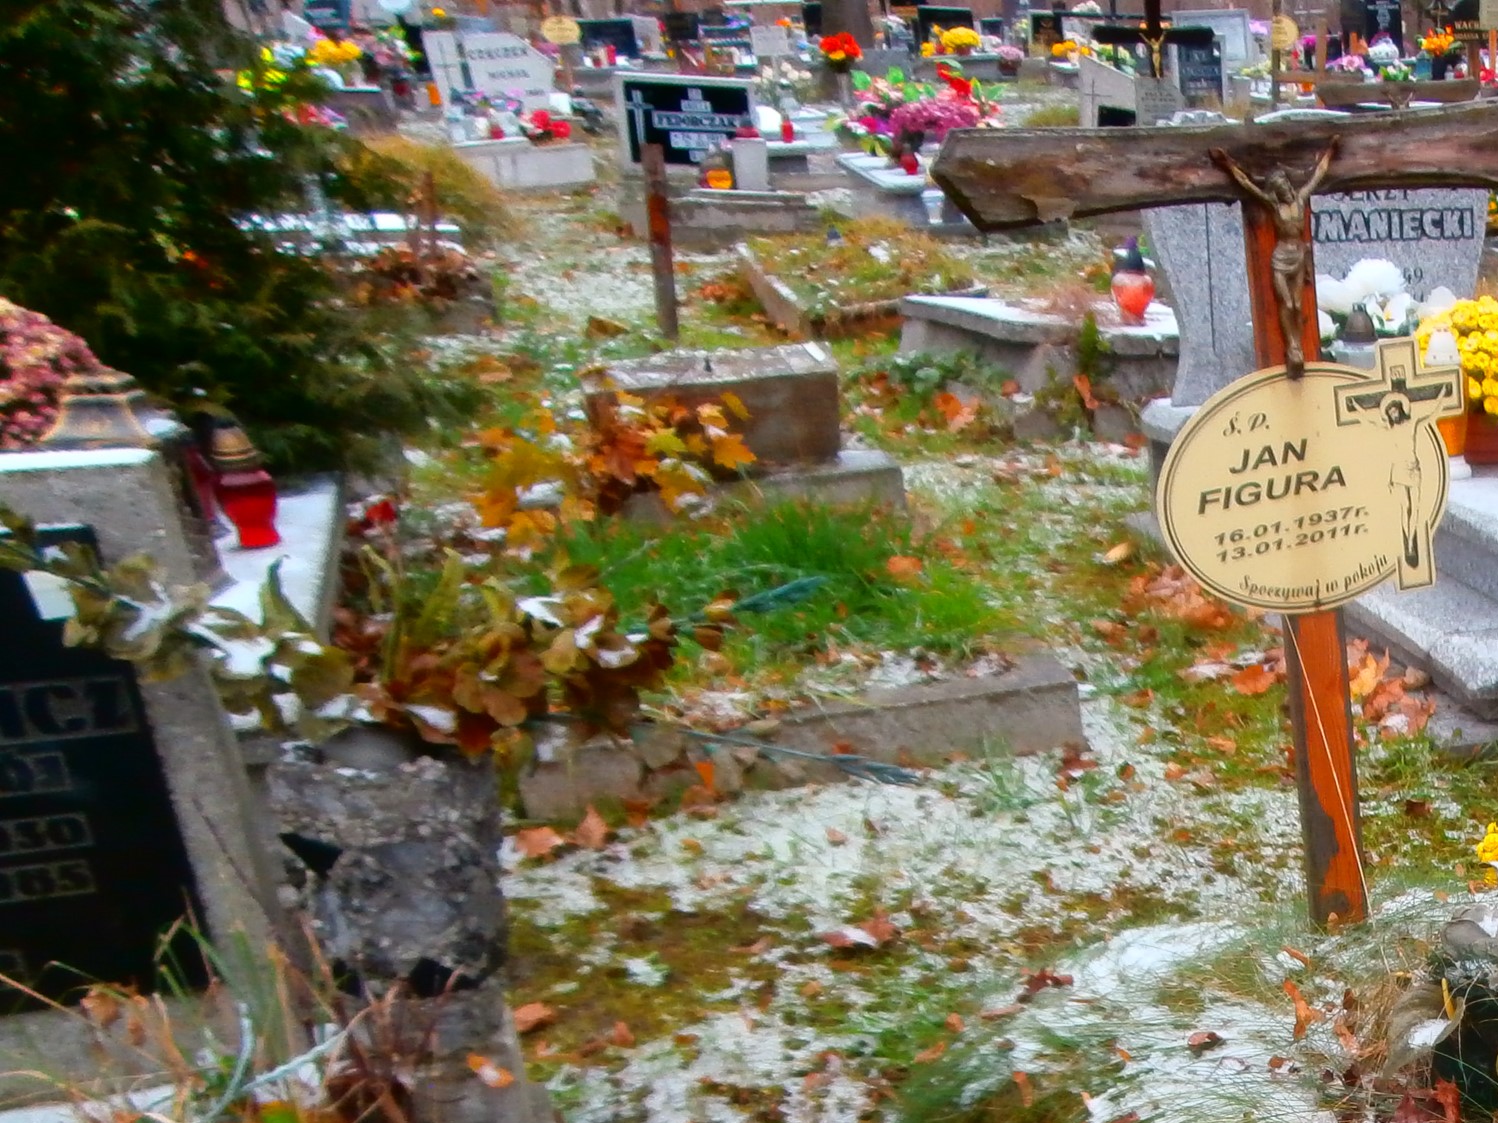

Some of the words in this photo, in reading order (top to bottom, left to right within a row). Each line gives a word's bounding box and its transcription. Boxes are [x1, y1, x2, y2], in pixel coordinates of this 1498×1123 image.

[1312, 206, 1474, 243] MANIECKI
[1229, 438, 1308, 474] JAN
[1198, 465, 1347, 515] FIGURA
[1214, 506, 1370, 547] 16.01.1937r.
[1216, 523, 1369, 563] 13.01.2011r.
[1239, 574, 1321, 602] Spoczywaj
[1325, 582, 1339, 594] w
[1343, 553, 1388, 592] pokoju
